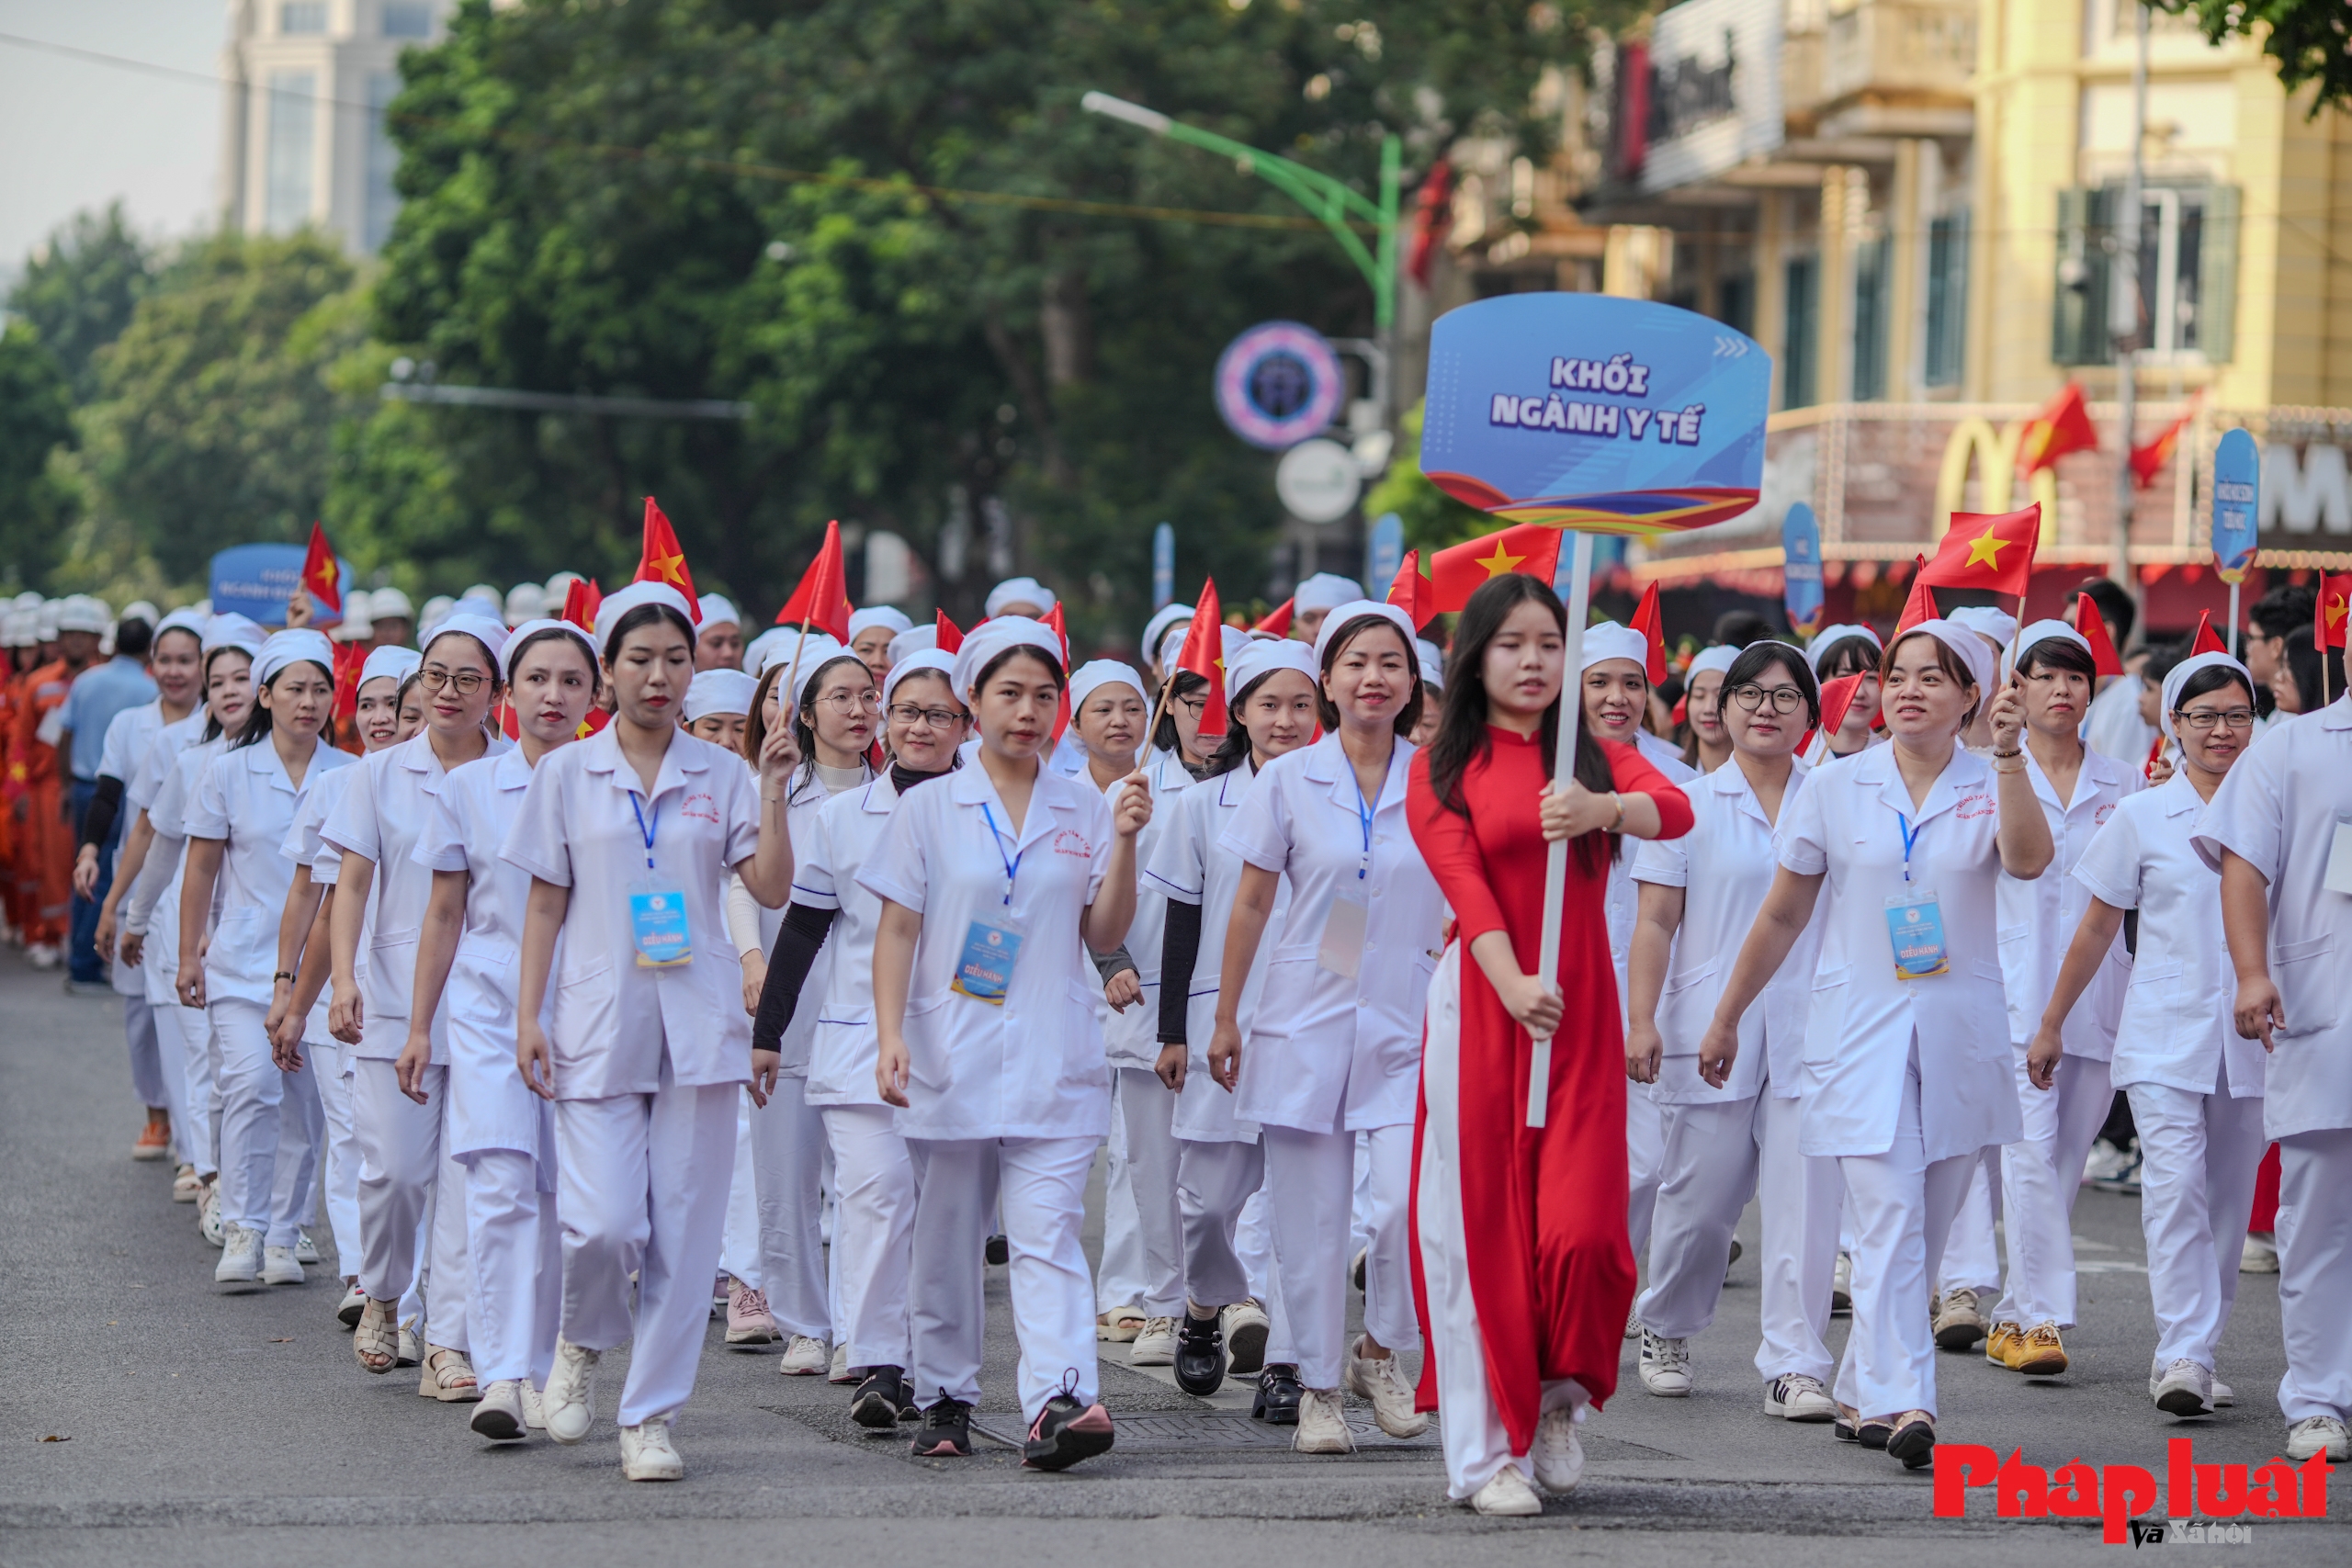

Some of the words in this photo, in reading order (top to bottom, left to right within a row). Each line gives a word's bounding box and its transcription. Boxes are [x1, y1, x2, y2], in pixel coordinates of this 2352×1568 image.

[1551, 353, 1650, 396] KHỐI
[1490, 391, 1621, 436] NGÀNH
[1625, 407, 1652, 441] Y
[1656, 402, 1706, 446] TẾ
[1957, 795, 1973, 811] TRUNG
[1918, 943, 1939, 956] HÀNH
